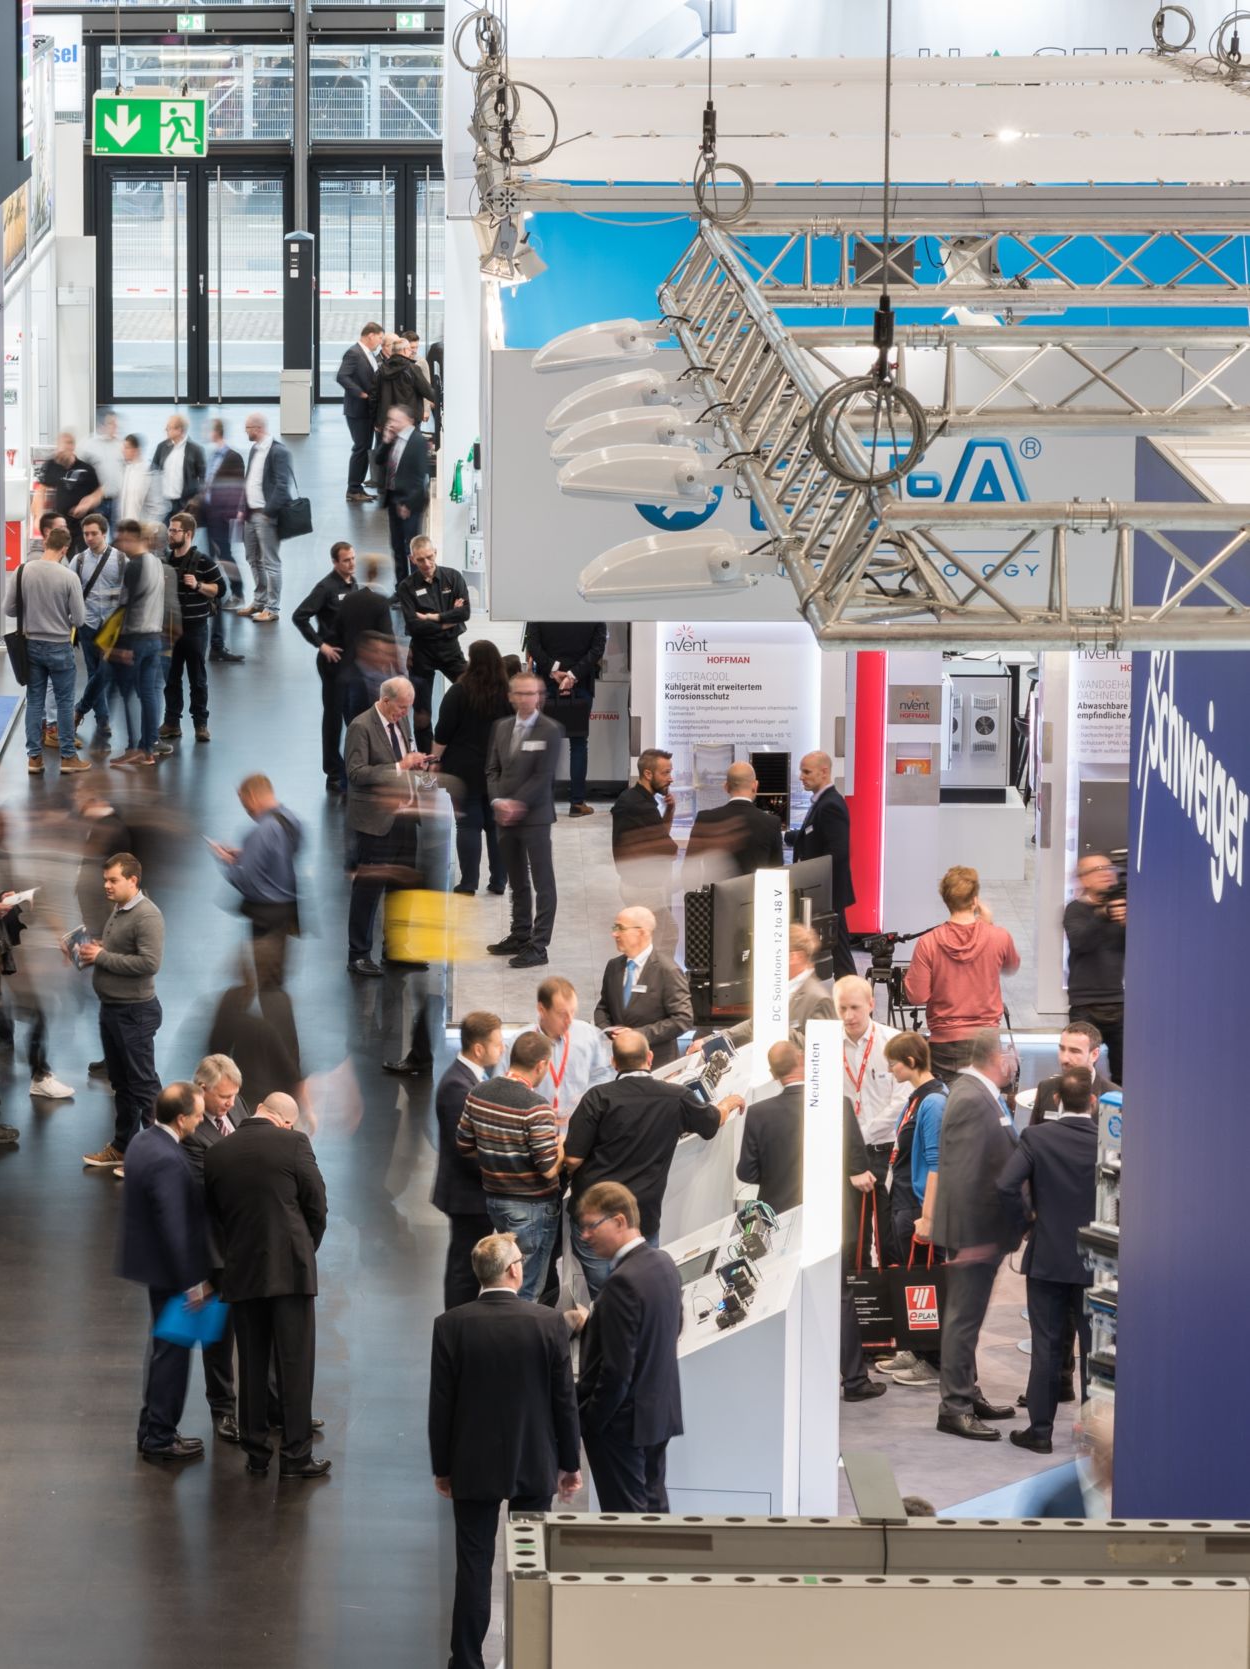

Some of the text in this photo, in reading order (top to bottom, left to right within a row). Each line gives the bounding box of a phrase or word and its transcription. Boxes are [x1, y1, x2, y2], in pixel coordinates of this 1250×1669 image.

[706, 656, 750, 664] HOFFMAN
[664, 672, 730, 681] SPECTRACOOL
[664, 683, 701, 692] Kühlgerät
[702, 683, 715, 691] mit
[664, 692, 730, 700] Korrosionsschutz
[1077, 702, 1128, 710] Abwaschbare
[900, 712, 930, 720] HOFFMAN
[1077, 712, 1126, 720] empfindliche
[1149, 650, 1249, 904] Schweiger
[774, 900, 782, 914] 48
[774, 918, 782, 926] to
[774, 931, 782, 943] 12
[772, 947, 782, 1002] Solutions
[772, 1006, 782, 1022] DC
[810, 1042, 820, 1108] Neuheiten
